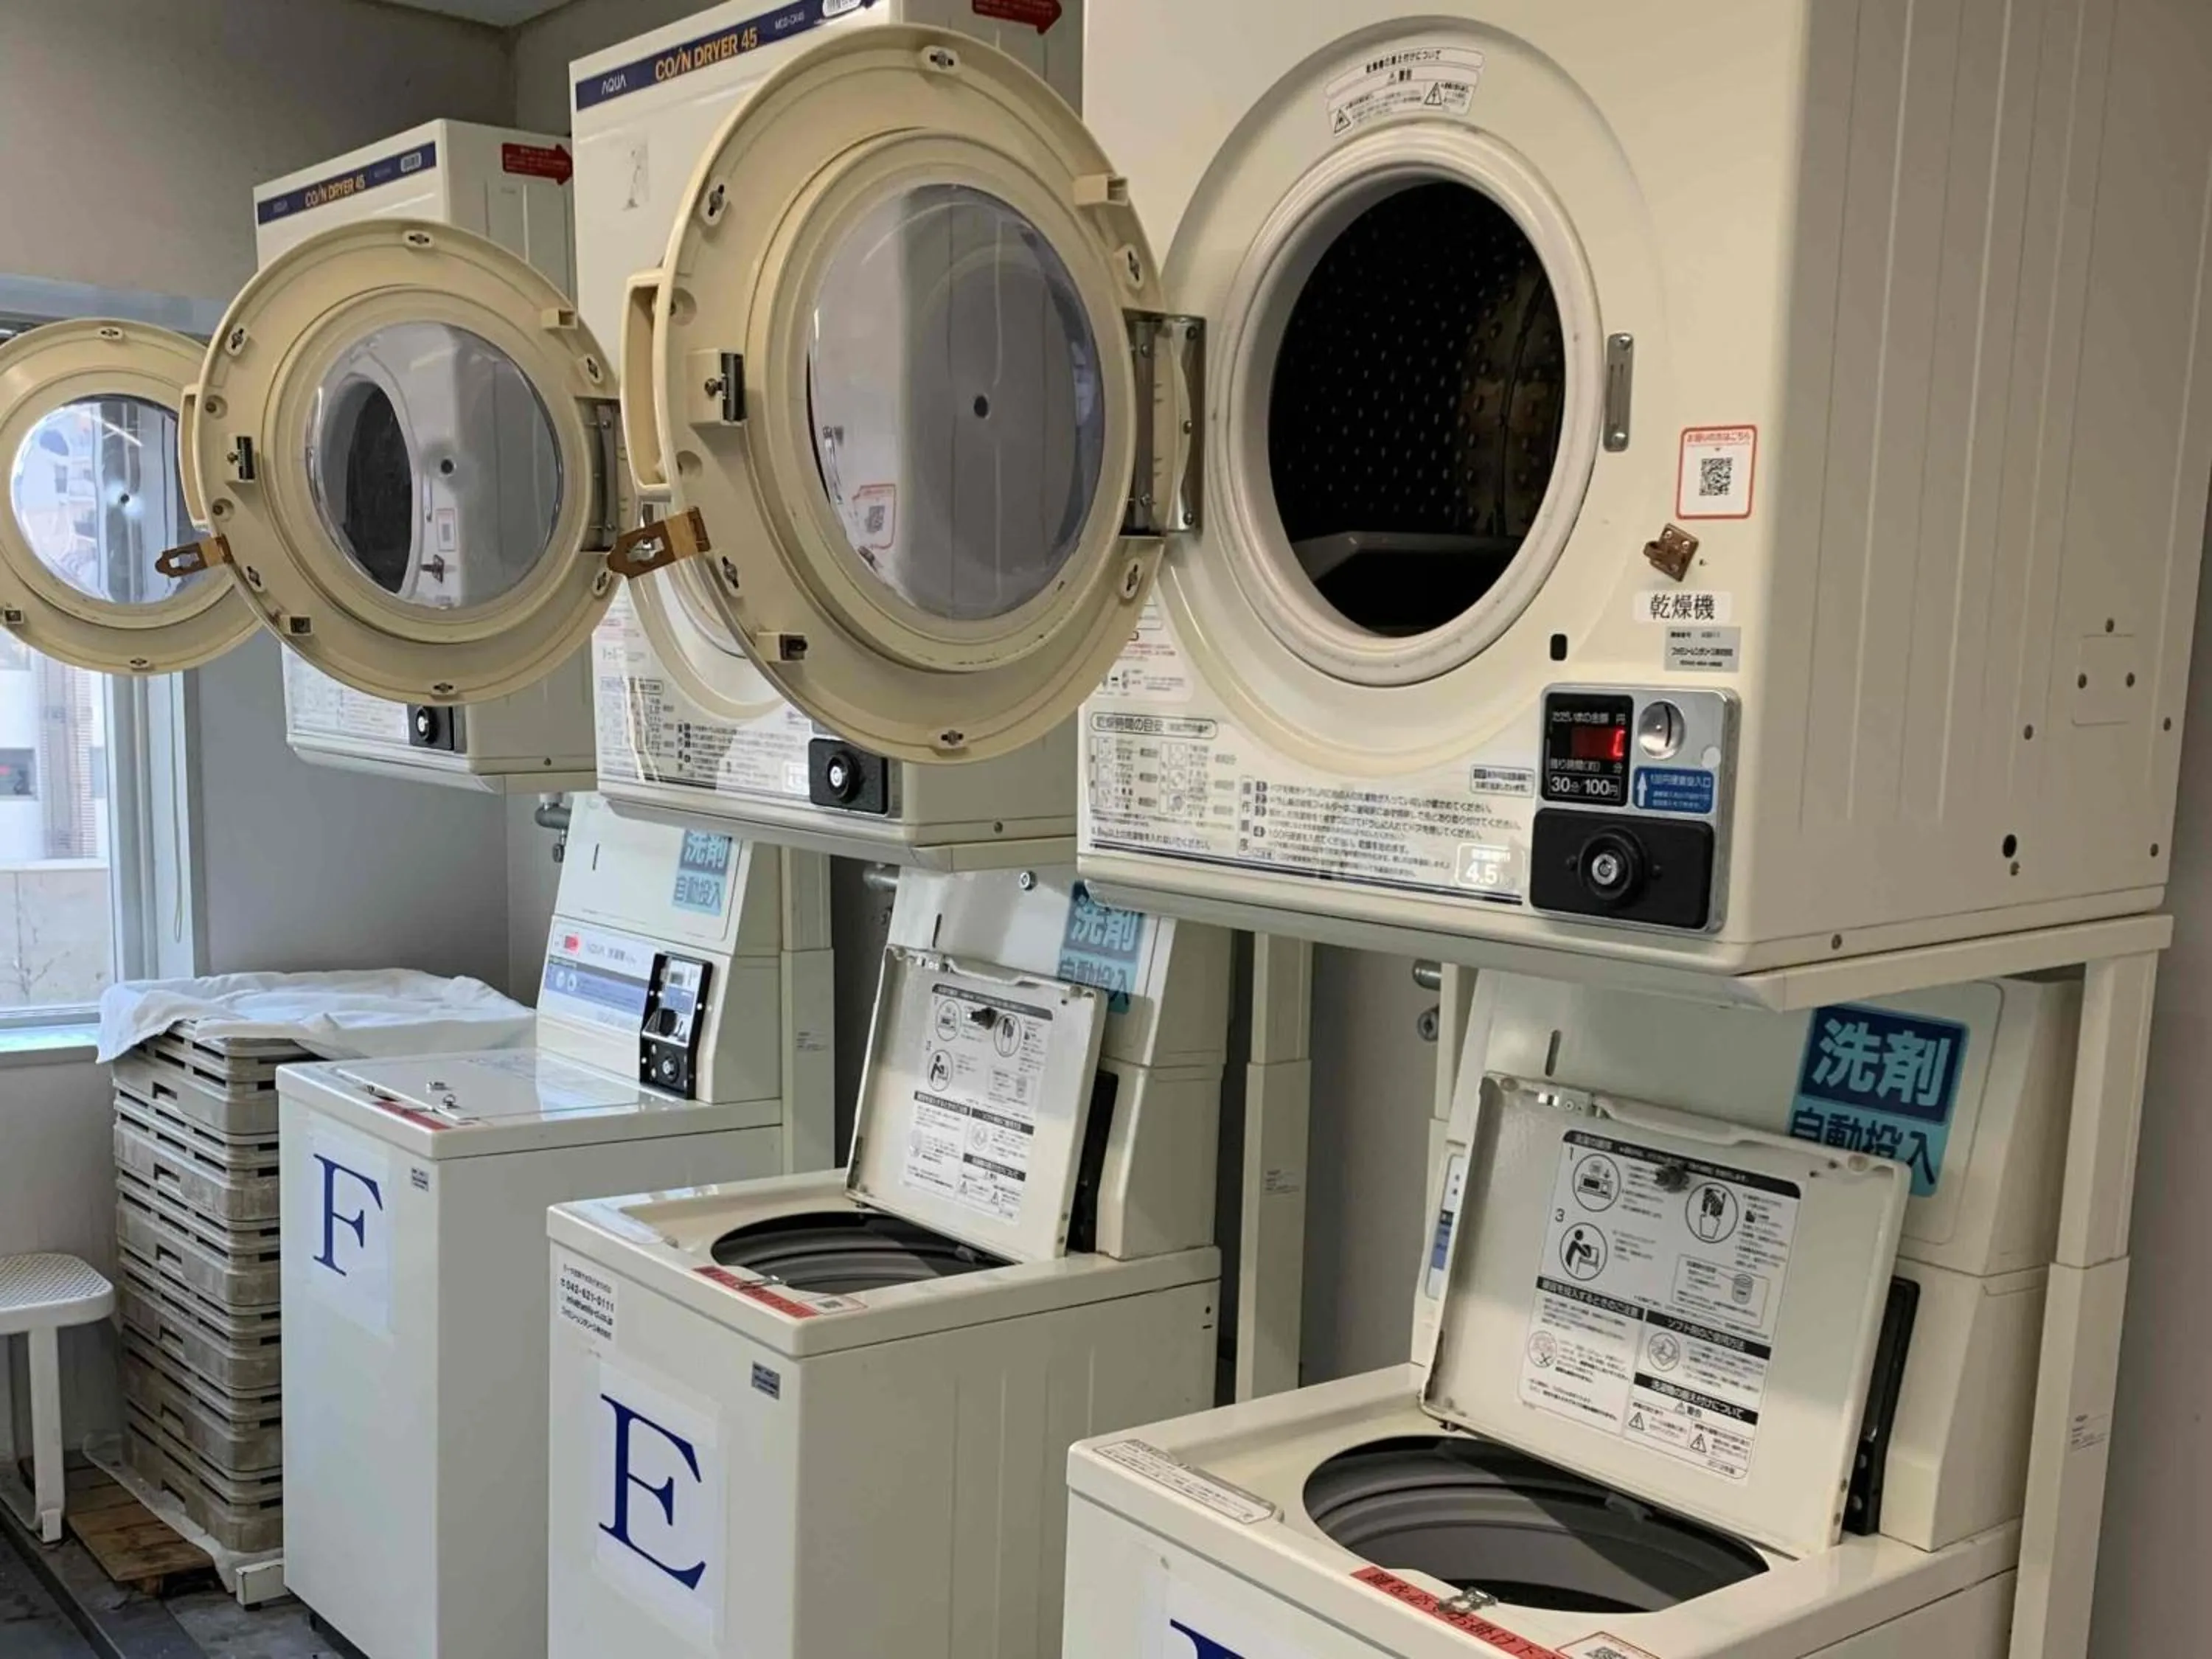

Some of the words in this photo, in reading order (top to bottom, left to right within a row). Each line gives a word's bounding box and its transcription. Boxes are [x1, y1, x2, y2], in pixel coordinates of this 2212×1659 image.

[601, 73, 627, 95] AQUA
[694, 34, 737, 66] DRYER
[740, 27, 759, 50] 45
[328, 179, 355, 202] DRYER
[355, 173, 366, 192] 45
[1649, 594, 1715, 620] 乾燥機
[1615, 713, 1627, 725] 円
[1071, 894, 1138, 952] 洗剤
[1812, 1018, 1952, 1107] 洗剤
[1789, 1107, 1936, 1185] 自動投入
[313, 1153, 383, 1276] F
[1556, 1208, 1565, 1222] 3
[599, 1393, 706, 1590] E
